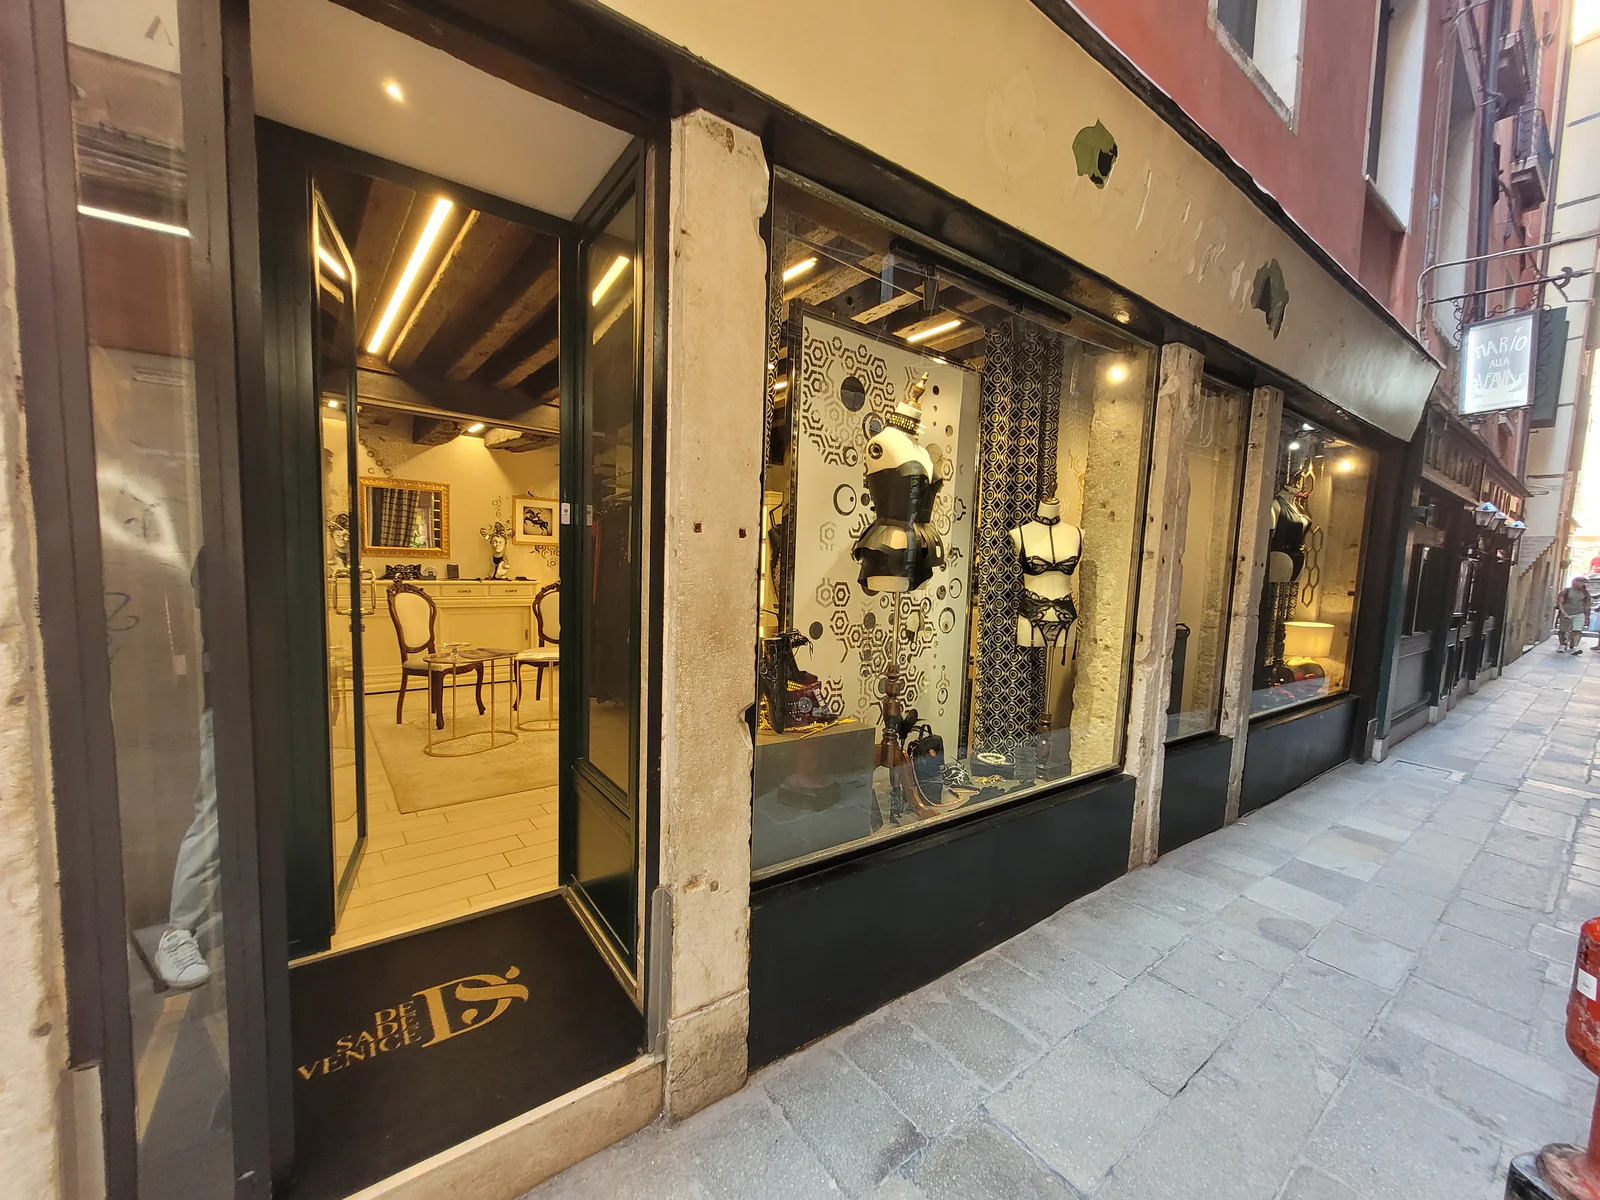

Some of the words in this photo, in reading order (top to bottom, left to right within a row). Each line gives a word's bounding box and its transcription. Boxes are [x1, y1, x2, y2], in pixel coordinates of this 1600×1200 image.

[1475, 334, 1529, 359] MARIO
[1489, 357, 1510, 369] ALLA
[374, 1000, 417, 1026] DE
[336, 1013, 420, 1053] SADE
[297, 1026, 422, 1081] VENICE
